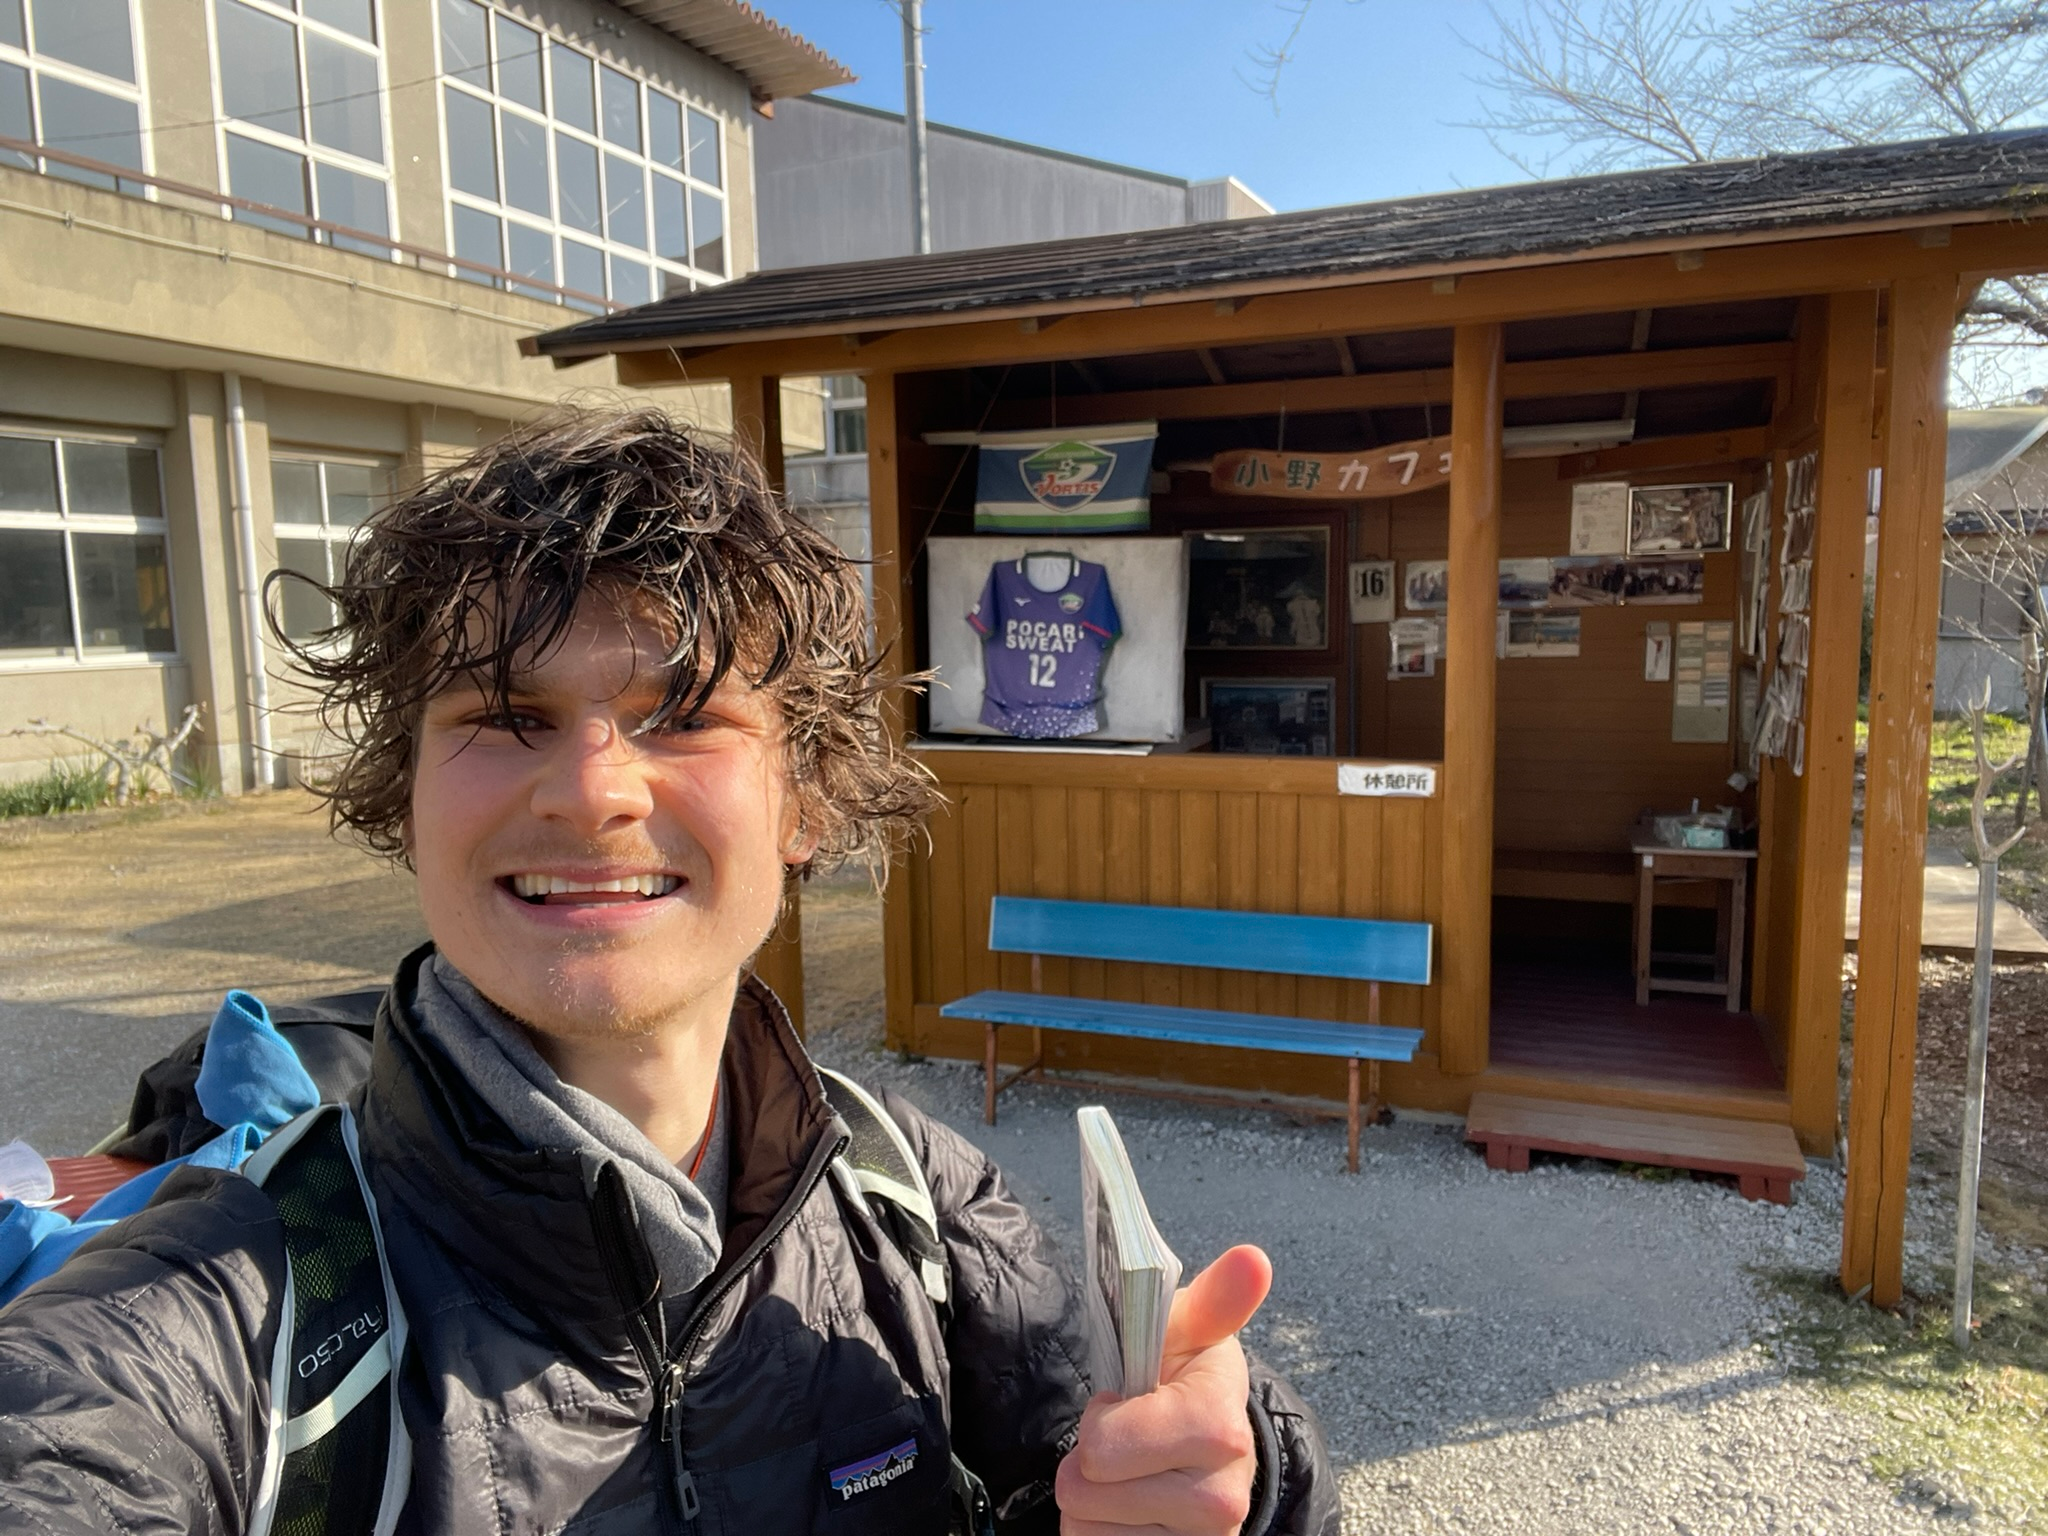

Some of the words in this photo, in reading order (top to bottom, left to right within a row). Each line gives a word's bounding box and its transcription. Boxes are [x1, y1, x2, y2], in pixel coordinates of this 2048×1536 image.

[1361, 568, 1384, 598] 16
[1005, 634, 1077, 653] SWEAT
[1029, 653, 1057, 688] 12
[1363, 773, 1428, 791] 休憩所
[298, 1304, 384, 1378] osprey
[841, 1458, 915, 1501] patagonia
